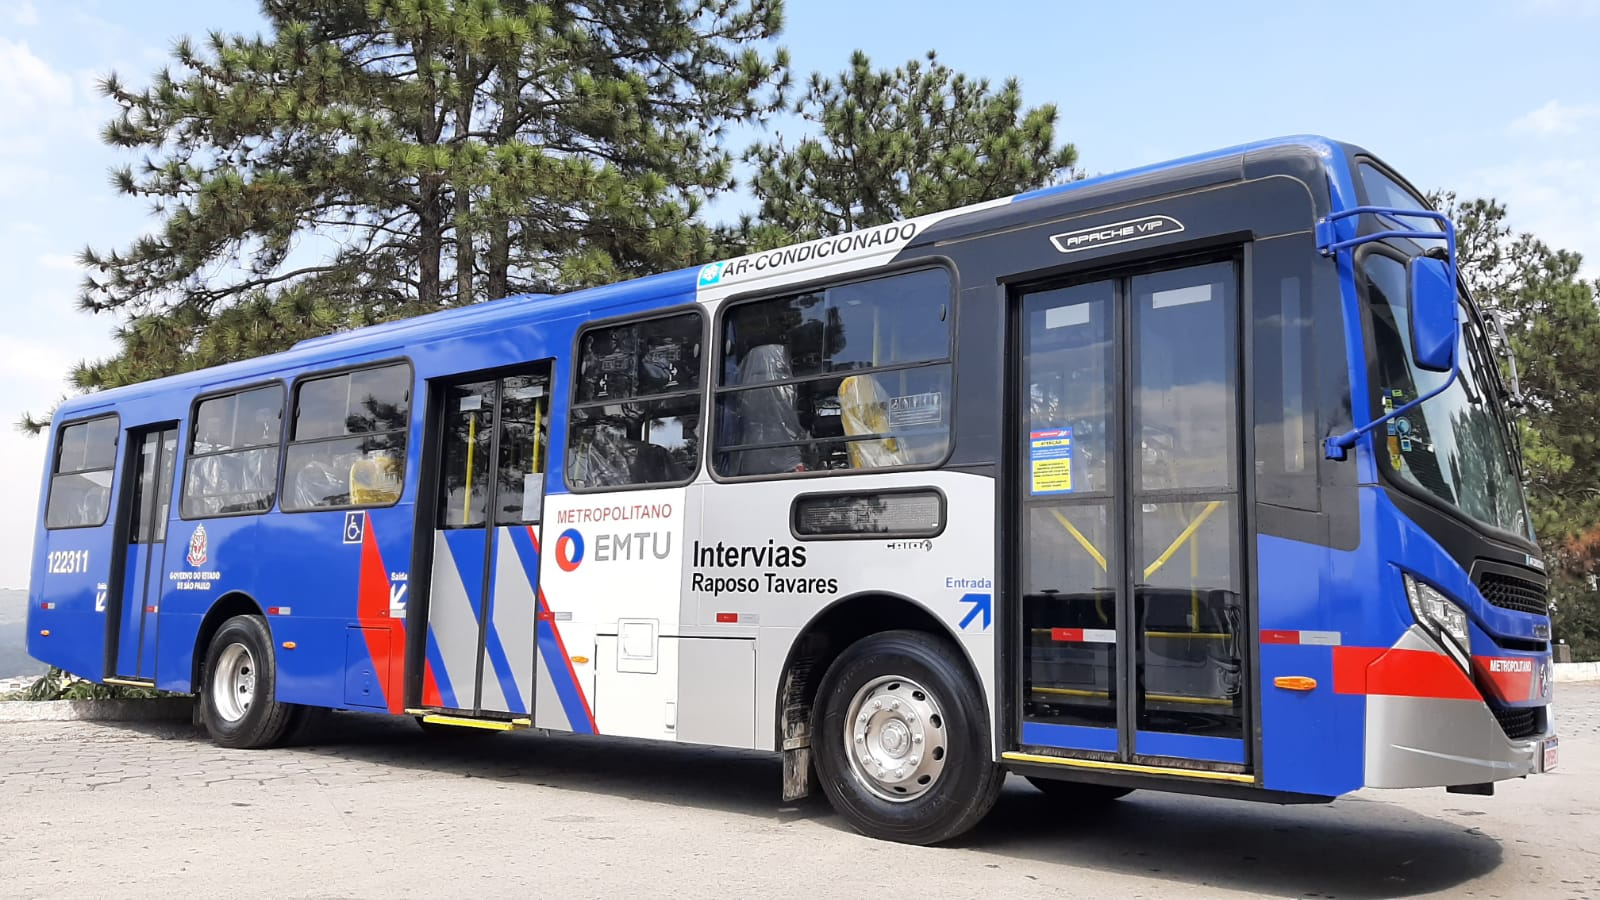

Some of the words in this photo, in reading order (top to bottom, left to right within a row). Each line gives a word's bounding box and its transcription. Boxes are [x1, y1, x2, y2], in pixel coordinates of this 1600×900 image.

[1067, 225, 1134, 246] APACHE
[1137, 220, 1162, 232] VIP
[722, 222, 916, 278] AR-CONDICIONADO
[557, 503, 672, 524] METROPOLITANO
[594, 531, 671, 562] EMTU
[693, 539, 807, 568] Intervias
[48, 550, 88, 573] 122311
[692, 572, 760, 597] Raposo
[764, 573, 838, 594] Tavares
[945, 576, 992, 589] Entrada
[1490, 659, 1532, 672] METROPOLITANO
